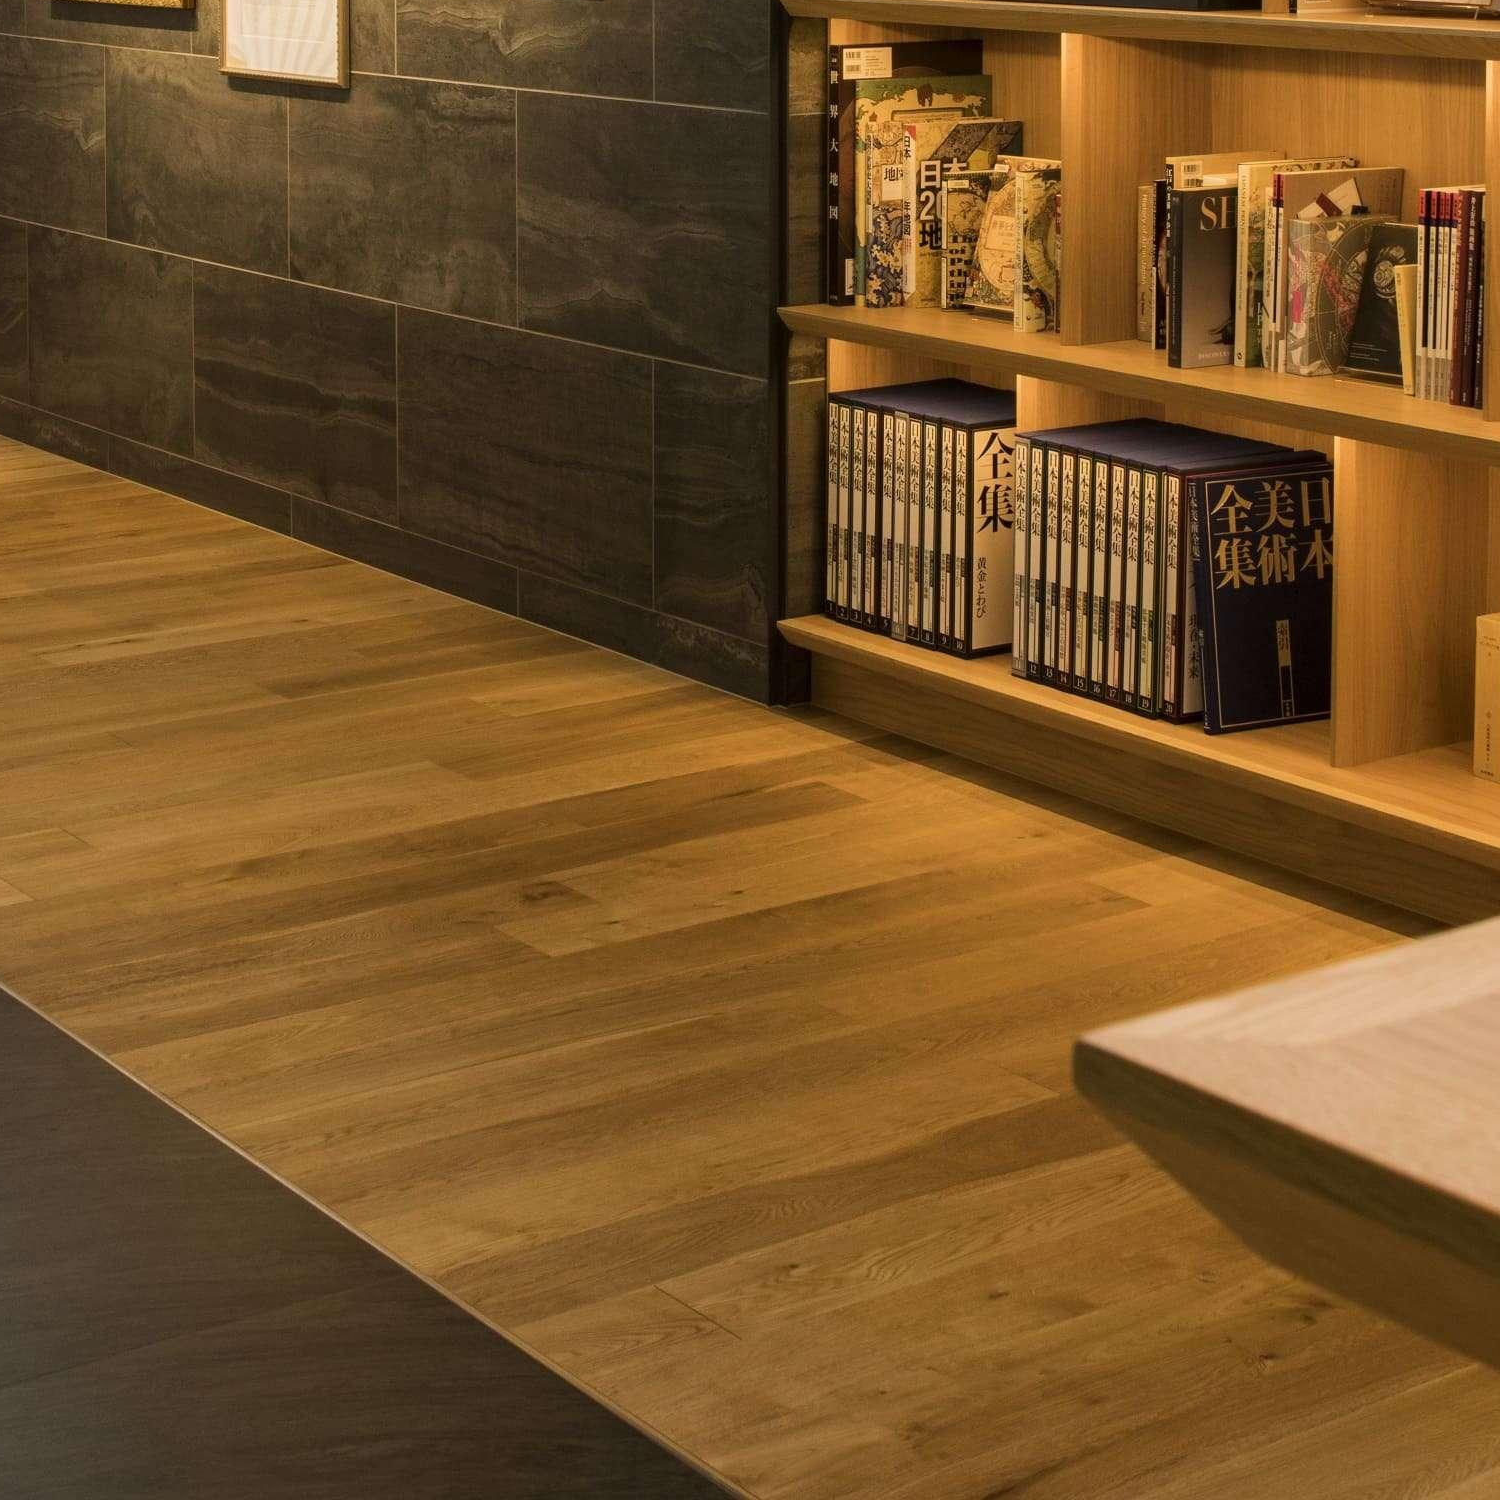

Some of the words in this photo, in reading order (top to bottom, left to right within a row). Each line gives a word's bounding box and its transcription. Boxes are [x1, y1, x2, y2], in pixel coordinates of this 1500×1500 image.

[828, 70, 839, 220] 世界大地図
[829, 403, 838, 484] 日本美術全集
[839, 407, 849, 489] 日本美術全集
[853, 409, 863, 491] 日本美術全集
[867, 412, 877, 496] 日本美術全集
[883, 415, 893, 500] 日本美術全集
[896, 418, 906, 503] 日本美術全集
[910, 421, 920, 506] 日本美術全集
[925, 424, 935, 509] 日本美術全集
[942, 427, 952, 512] 日本美術全集
[956, 430, 966, 516] 日本美術全集
[976, 431, 1015, 534] 全集
[1031, 448, 1042, 536] 日本美術全集
[1047, 451, 1058, 540] 日本美術全集
[1062, 454, 1073, 544] 日本美術全集
[1079, 458, 1090, 548] 日本美術全集
[1095, 462, 1106, 553] 日本美術全集
[1112, 466, 1123, 557] 日本美術全集
[1128, 470, 1140, 562] 日本美術全集
[1144, 473, 1156, 565] 日本美術全集
[1167, 476, 1179, 569] 日本美術全集
[1256, 480, 1299, 587] 美術
[1299, 475, 1335, 581] 日本
[1212, 484, 1257, 591] 全集
[978, 556, 987, 619] 黄金とわび
